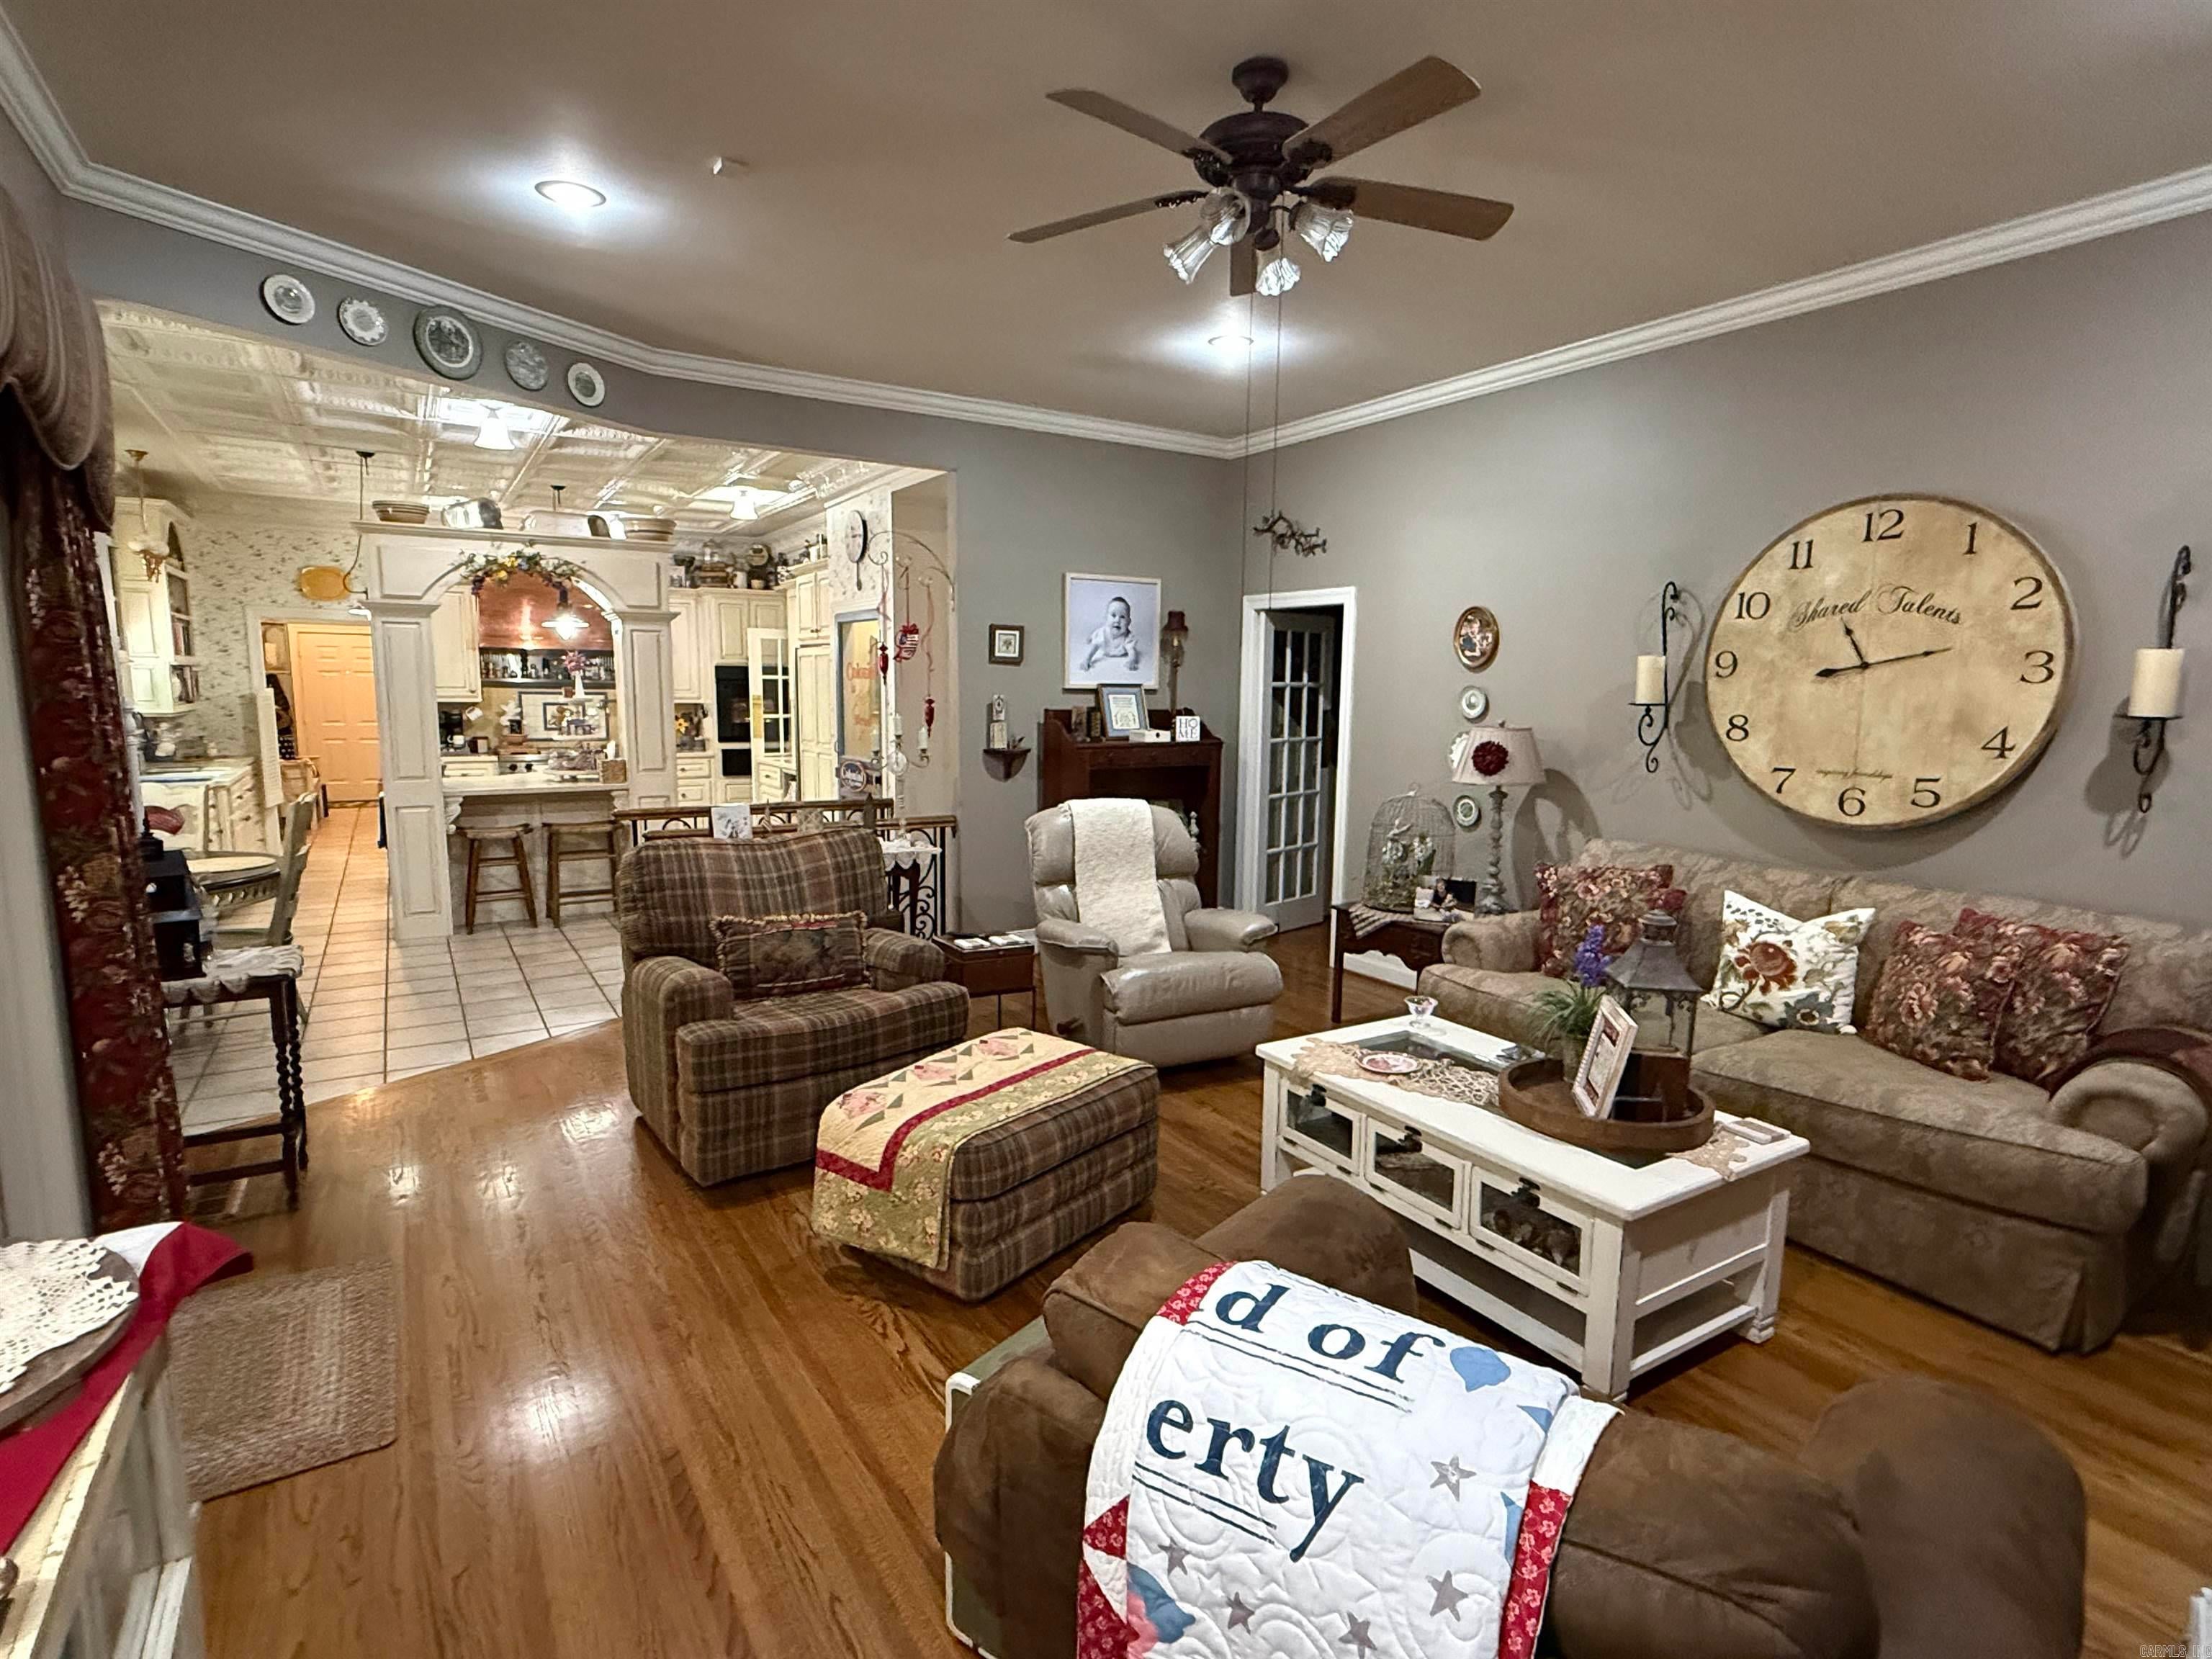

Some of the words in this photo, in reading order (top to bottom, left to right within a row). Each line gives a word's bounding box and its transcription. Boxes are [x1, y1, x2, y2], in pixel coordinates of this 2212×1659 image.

[1862, 508, 1905, 542] 12
[1964, 522, 1979, 556] 1
[1789, 539, 1815, 570] 11
[1735, 591, 1771, 620] 10
[1789, 590, 1871, 631] Shared
[1876, 583, 1964, 625] Talents
[2011, 577, 2044, 611] 2
[1714, 650, 1738, 678] 9
[2020, 650, 2055, 685] 3
[1725, 714, 1750, 742] 8
[1981, 726, 2017, 760] 4
[1771, 767, 1797, 794] 7
[1910, 778, 1942, 809] 5
[1838, 788, 1866, 817] 6
[1308, 1323, 1446, 1384] of
[1146, 1398, 1364, 1563] erty
